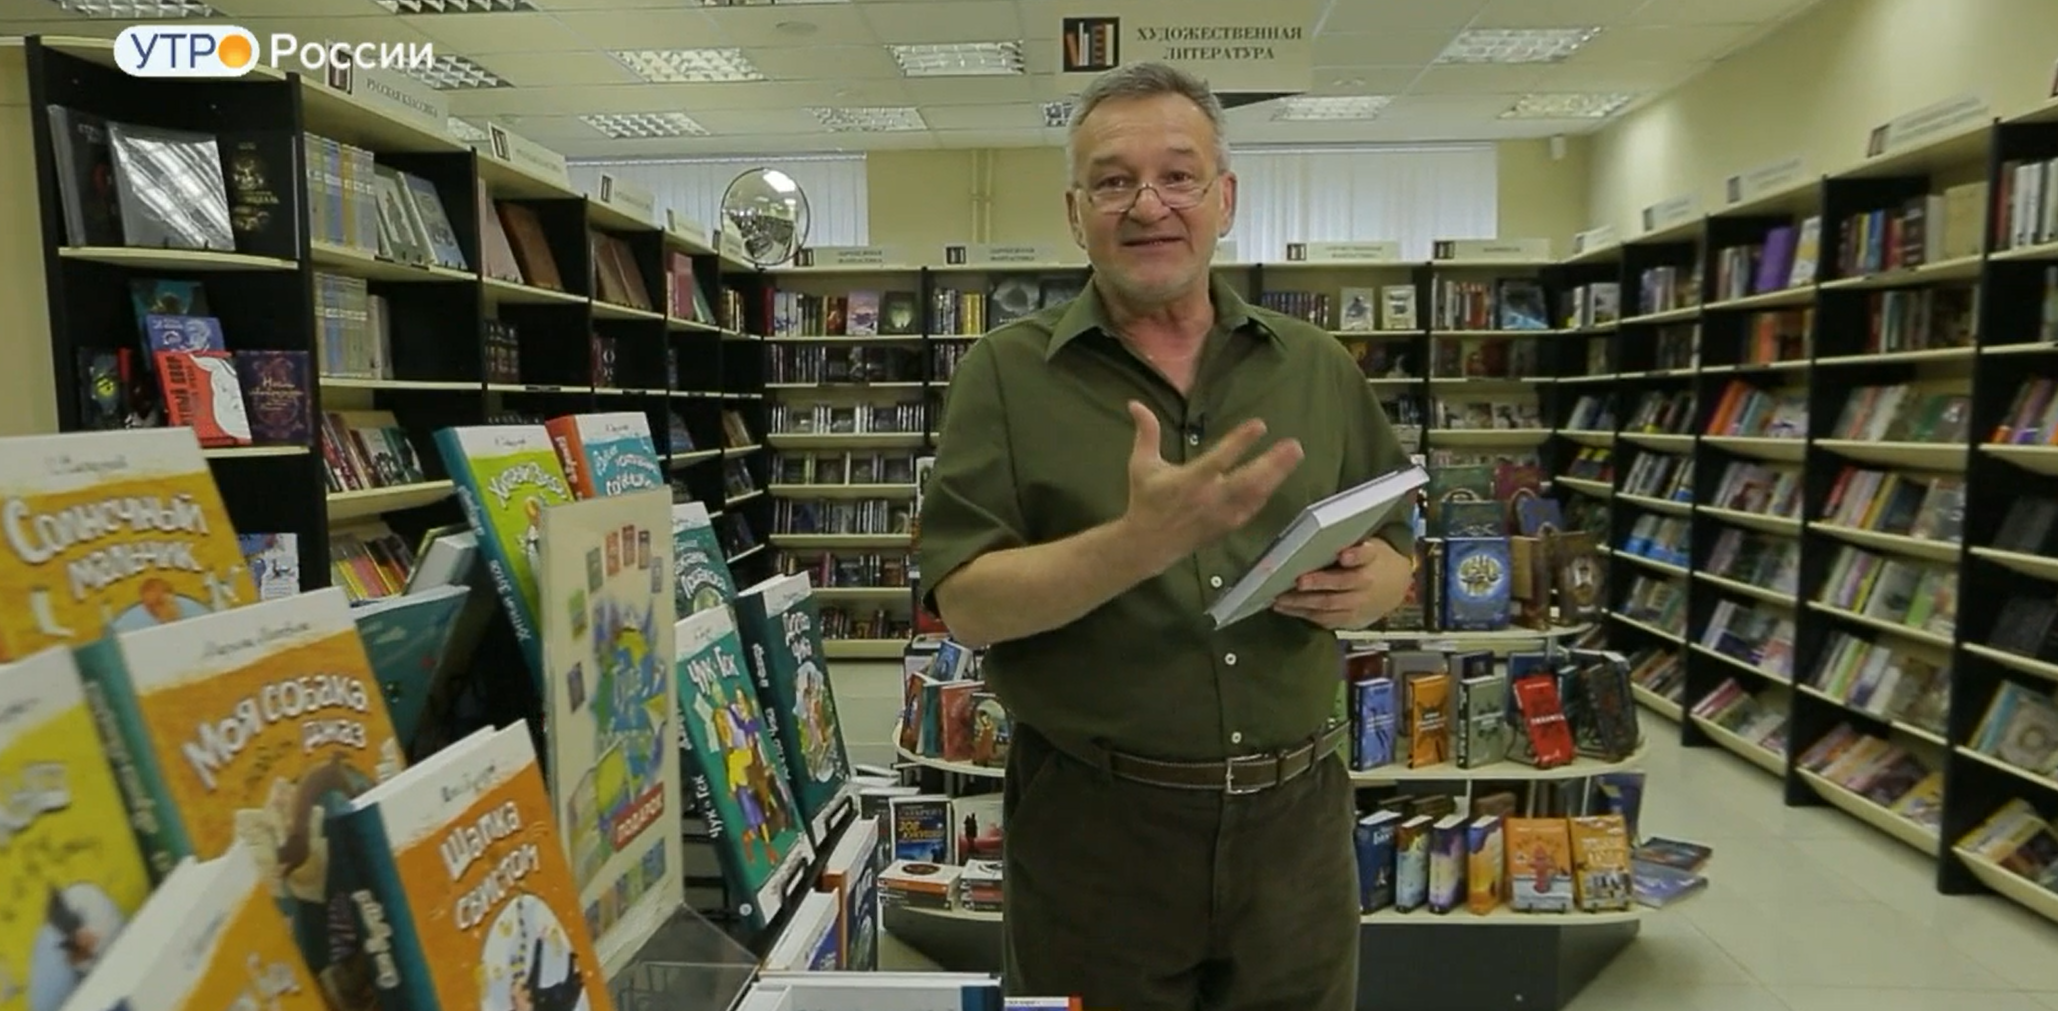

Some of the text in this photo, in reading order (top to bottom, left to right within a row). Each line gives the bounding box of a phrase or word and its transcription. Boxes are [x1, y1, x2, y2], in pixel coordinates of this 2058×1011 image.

[1137, 26, 1303, 42] ХУДОЖЕСТВЕННАЯ
[1163, 47, 1275, 61] ЛИТЕРАТУРА
[3, 493, 210, 564] Солнечный
[182, 698, 263, 790] Моя
[616, 792, 663, 844] ПОДАРОК
